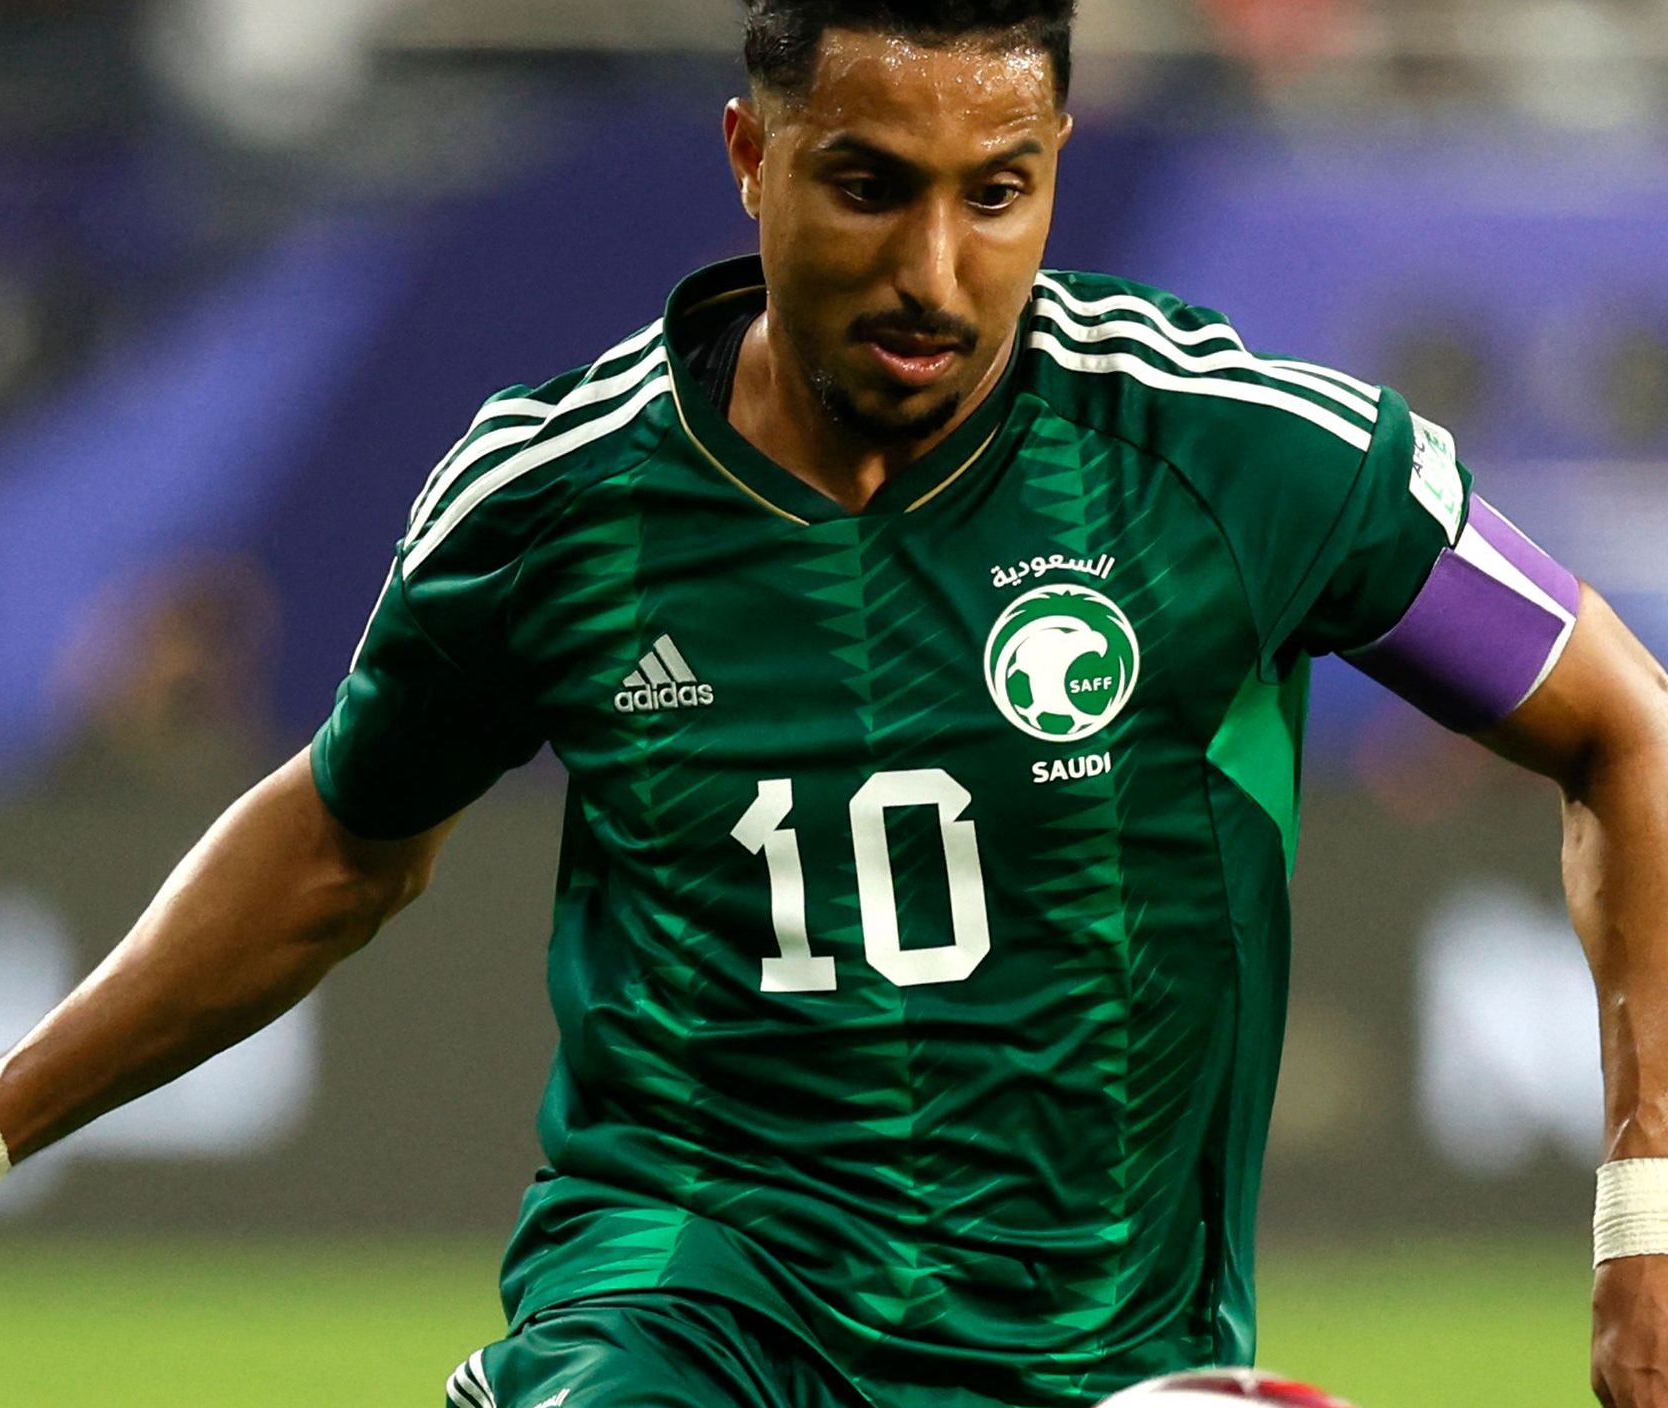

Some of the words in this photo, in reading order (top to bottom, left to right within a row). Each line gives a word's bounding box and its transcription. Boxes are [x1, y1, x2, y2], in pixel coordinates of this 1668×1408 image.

[990, 553, 1115, 588] السعودية
[614, 680, 714, 713] adidas
[1069, 676, 1112, 694] SAFF
[1032, 752, 1111, 783] SAUDI
[731, 769, 990, 992] 10
